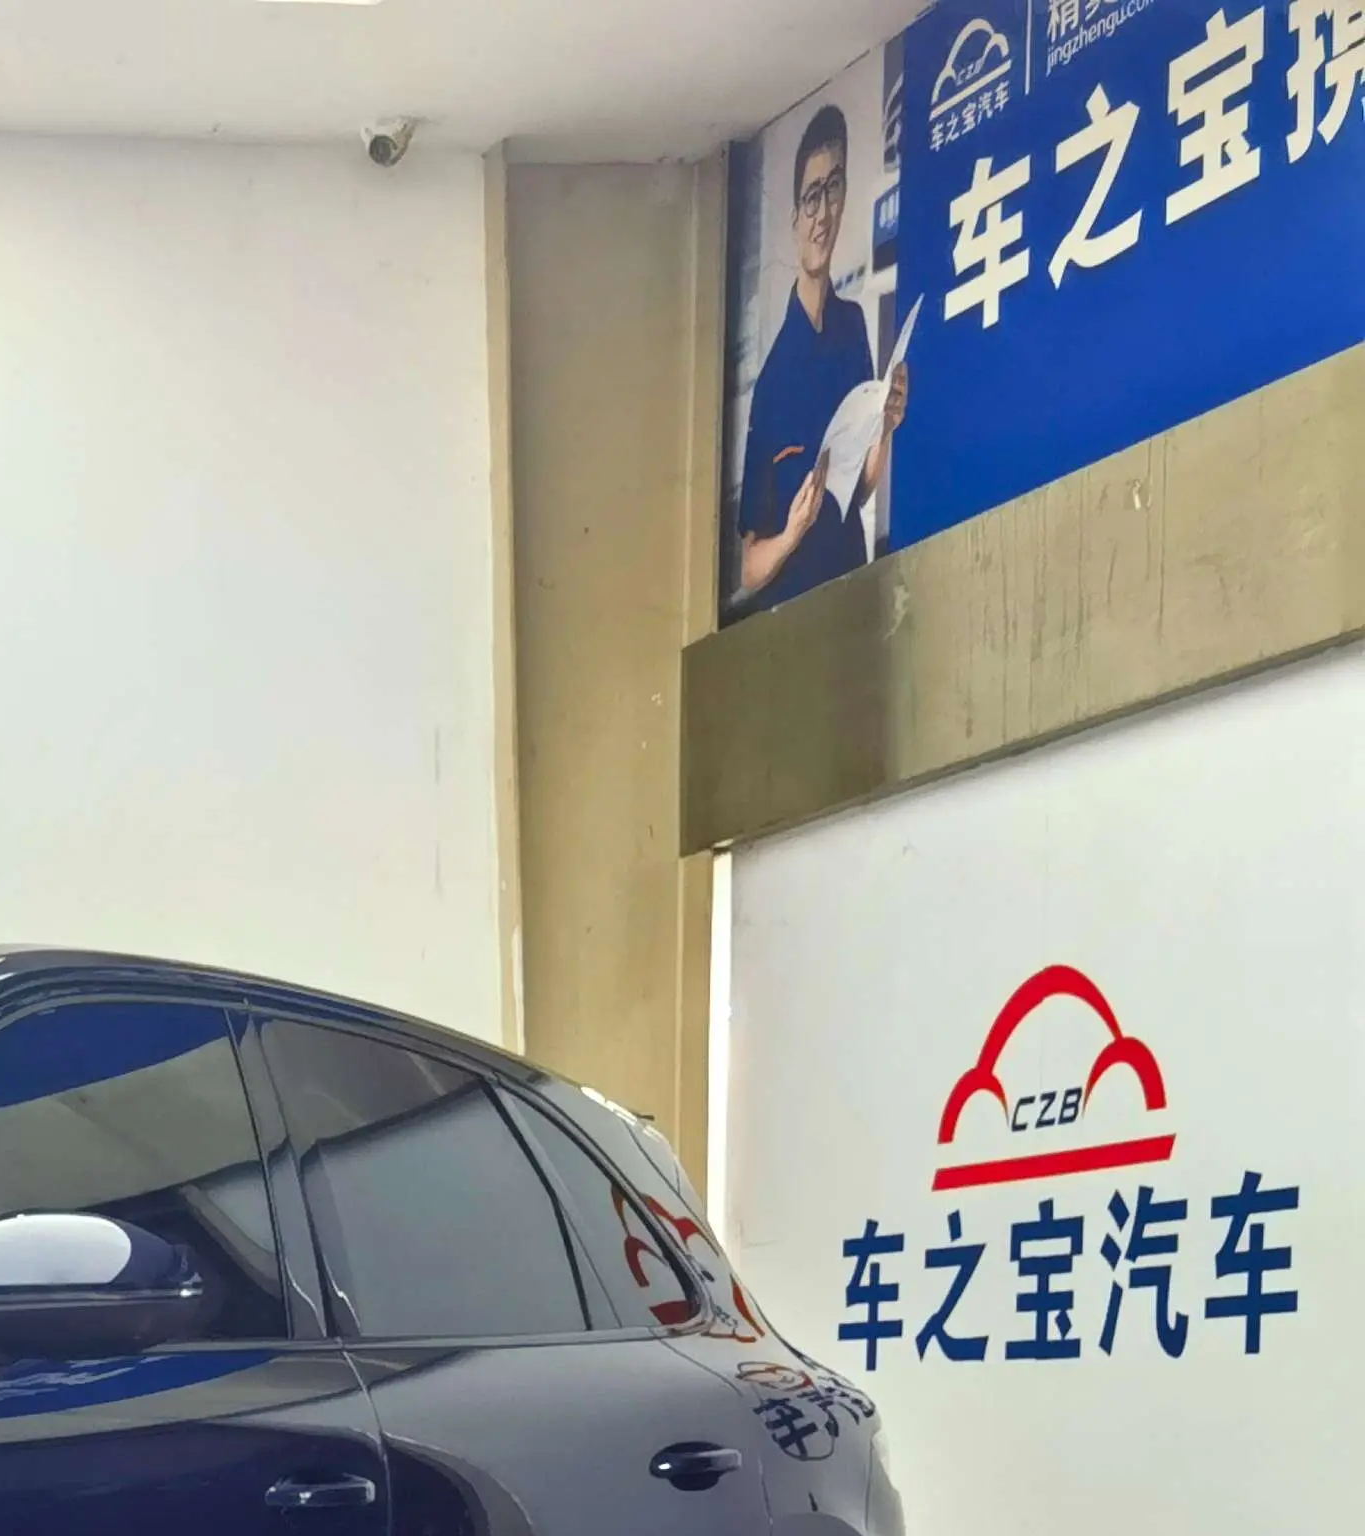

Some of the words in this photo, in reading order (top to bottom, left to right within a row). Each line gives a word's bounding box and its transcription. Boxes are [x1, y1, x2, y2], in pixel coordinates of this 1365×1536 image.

[930, 80, 1009, 152] 车之宝汽车
[1010, 1086, 1083, 1132] CZB
[837, 1169, 1300, 1372] 车之宝汽车
